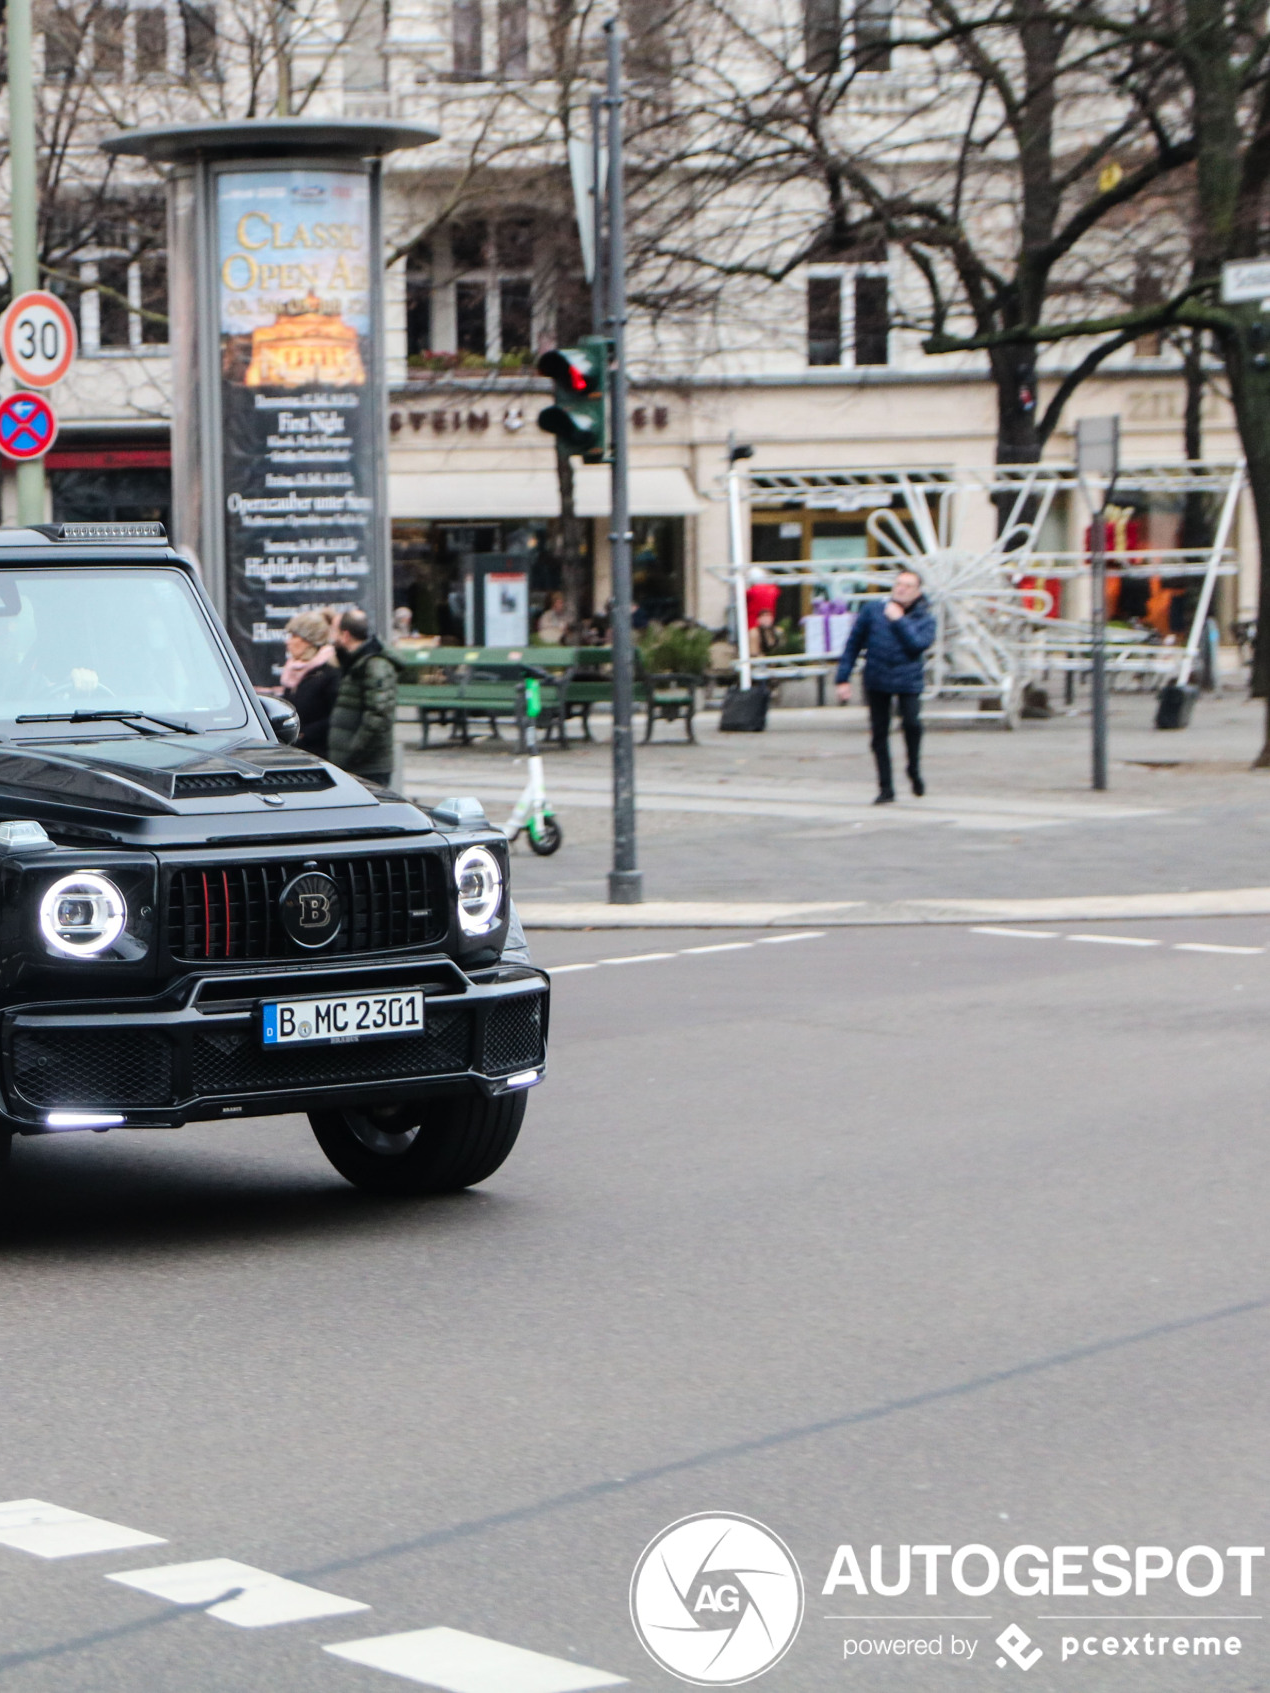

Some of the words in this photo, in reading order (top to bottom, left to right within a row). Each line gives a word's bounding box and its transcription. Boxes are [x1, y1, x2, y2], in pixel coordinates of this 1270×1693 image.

[237, 210, 361, 250] CLASSIC
[222, 253, 320, 292] OPEN
[19, 320, 58, 360] 30
[389, 410, 489, 433] STEIN
[299, 894, 330, 928] B
[280, 1008, 296, 1037] B
[315, 1002, 349, 1034] MC
[356, 996, 420, 1031] 2301
